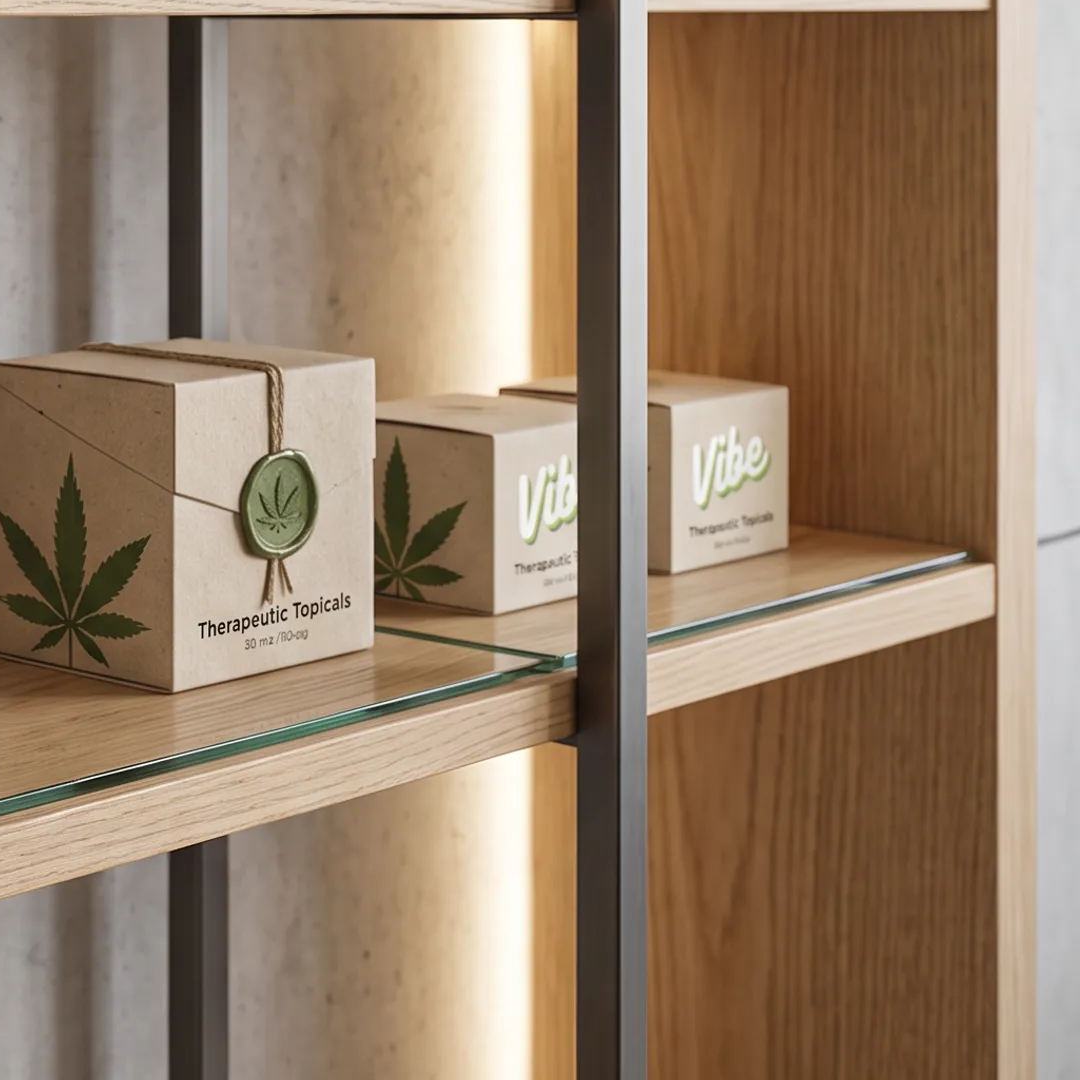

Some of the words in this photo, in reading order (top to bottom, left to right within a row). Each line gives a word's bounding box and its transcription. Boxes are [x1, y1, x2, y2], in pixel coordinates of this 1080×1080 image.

[518, 454, 578, 546] Vib
[692, 425, 772, 511] Vibe
[197, 605, 289, 640] Therapeutic
[292, 592, 352, 619] Topicals
[244, 637, 257, 650] 30
